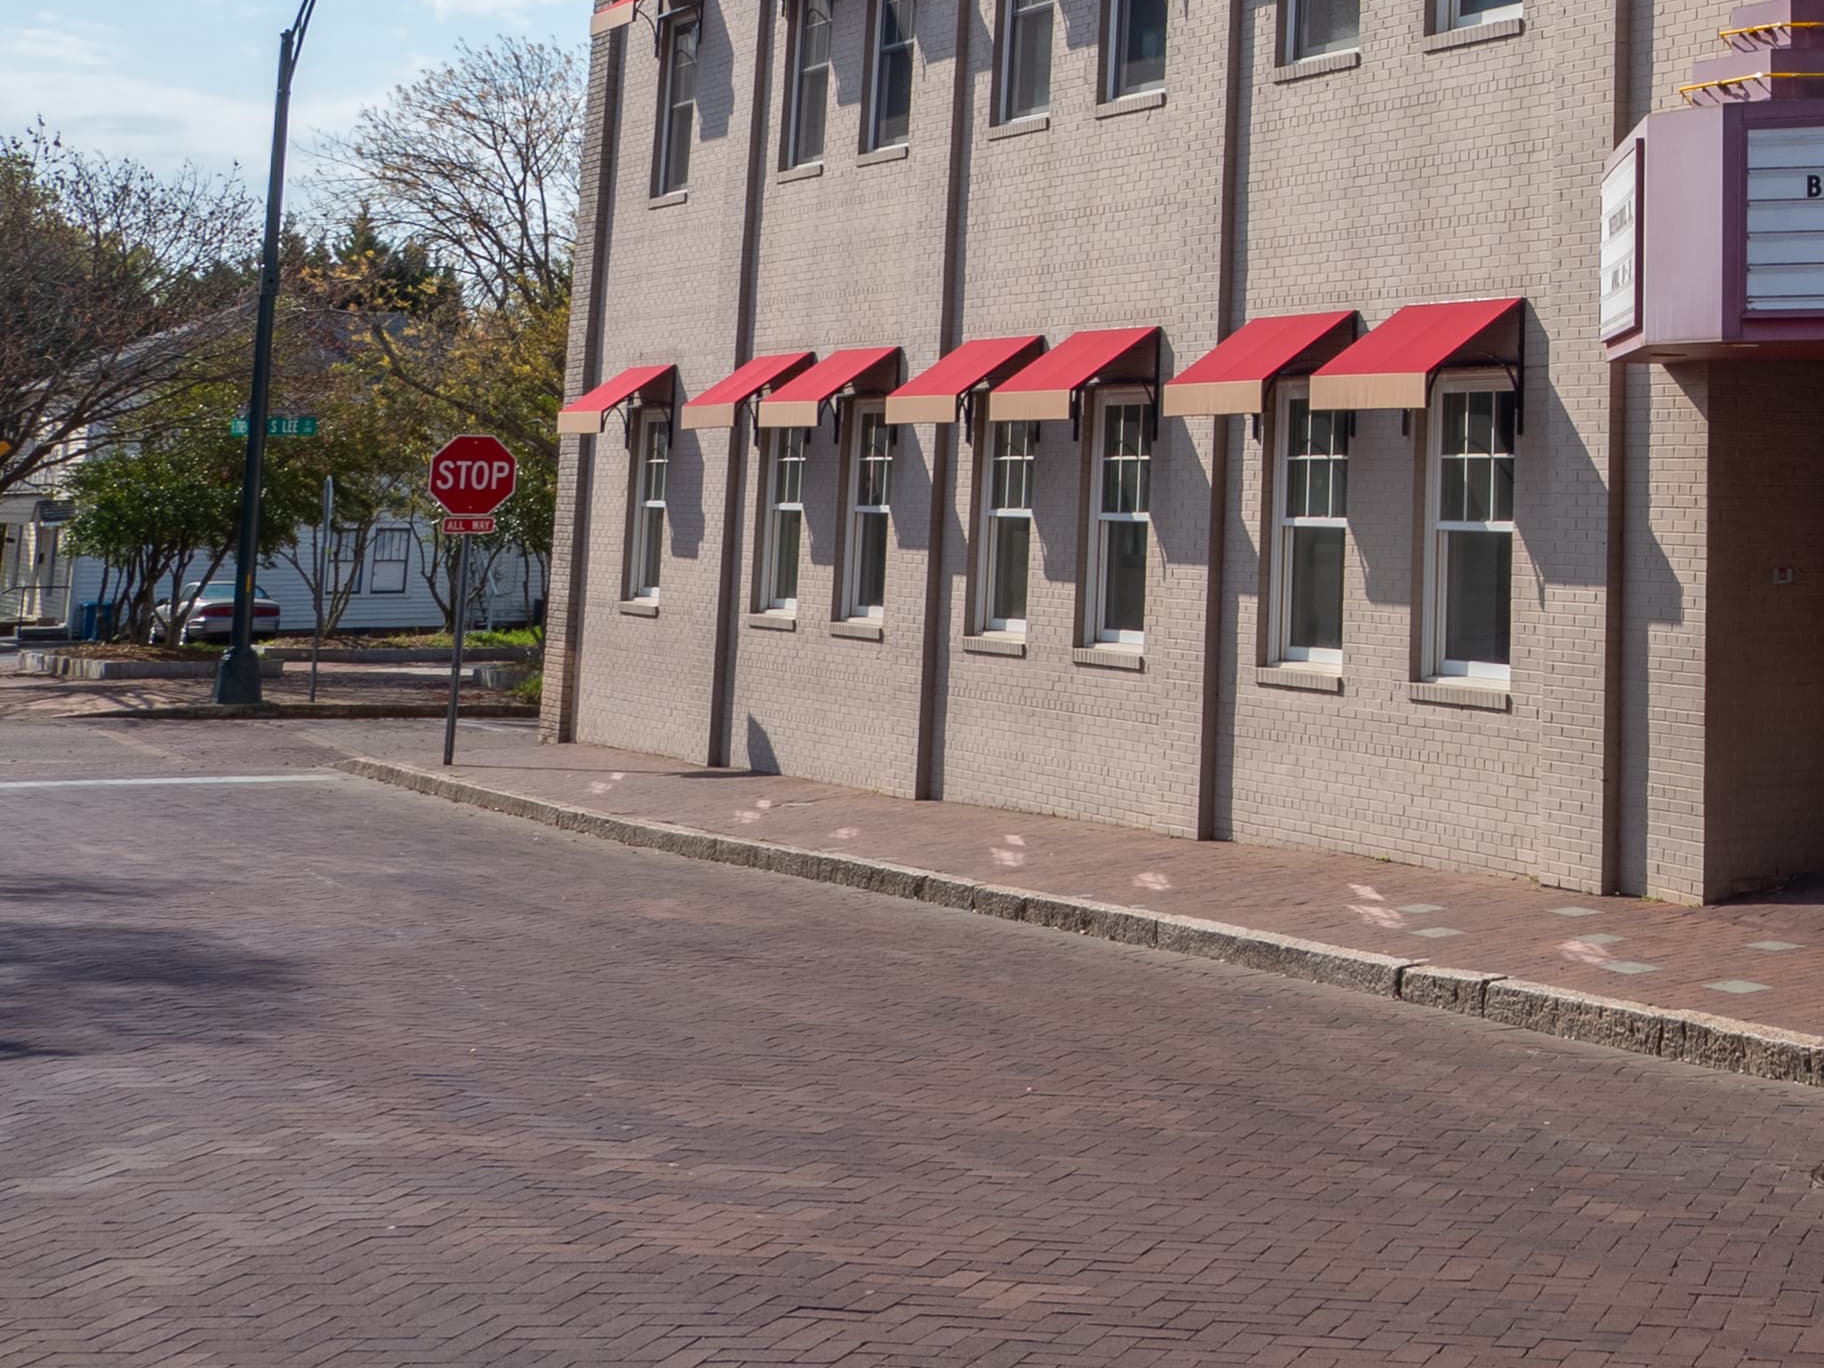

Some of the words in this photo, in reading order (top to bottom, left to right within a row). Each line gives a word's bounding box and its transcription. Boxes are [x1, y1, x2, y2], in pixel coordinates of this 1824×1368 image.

[270, 420, 277, 433] S
[282, 420, 299, 433] LEE
[436, 460, 510, 490] STOP
[447, 520, 464, 530] ALL
[472, 520, 490, 530] WAY
